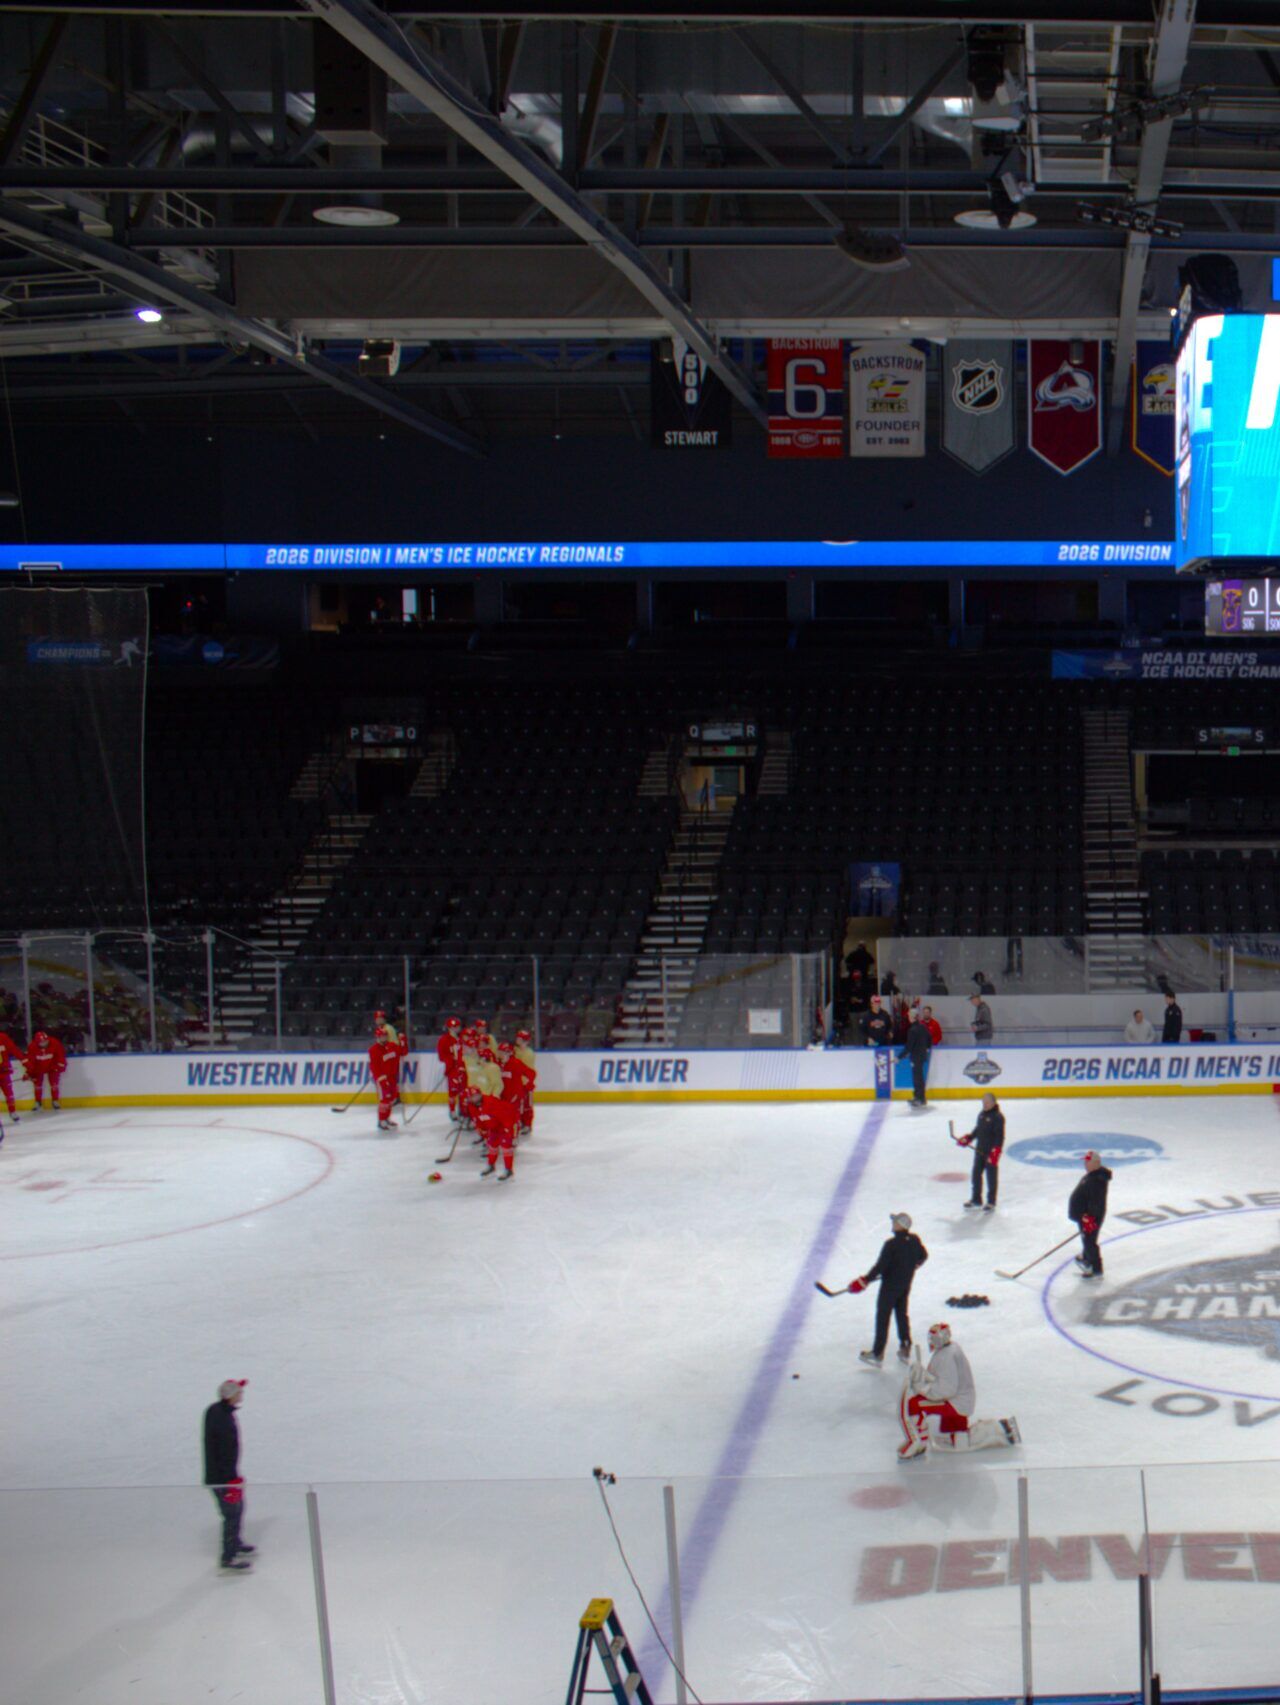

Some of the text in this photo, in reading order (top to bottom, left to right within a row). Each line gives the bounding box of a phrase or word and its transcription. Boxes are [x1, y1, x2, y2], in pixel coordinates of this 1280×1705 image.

[771, 338, 840, 351] BACKSTROM
[852, 355, 923, 372] BACKSTROM
[784, 358, 826, 419] 6
[962, 373, 996, 404] NHL
[855, 420, 921, 431] FOUNDER
[664, 430, 719, 446] STEWART
[265, 547, 309, 565] 2026
[313, 547, 383, 565] DIVISION
[396, 546, 444, 564] MEN'S
[446, 546, 473, 563] ICE
[475, 546, 537, 563] HOCKEY
[539, 545, 625, 563] REGIONALS
[1058, 544, 1172, 561] 2026 DIVISION
[1141, 652, 1258, 666] NCAA DI MEN'S
[1141, 665, 1170, 678] ICE
[1173, 665, 1235, 678] HOCKEY
[187, 1060, 419, 1087] WESTERN MICHIN
[598, 1057, 689, 1084] DENVER
[1042, 1058, 1102, 1081] 2026
[1104, 1057, 1162, 1080] NCAA
[1167, 1056, 1191, 1079] DI
[1193, 1055, 1263, 1079] MEN'S
